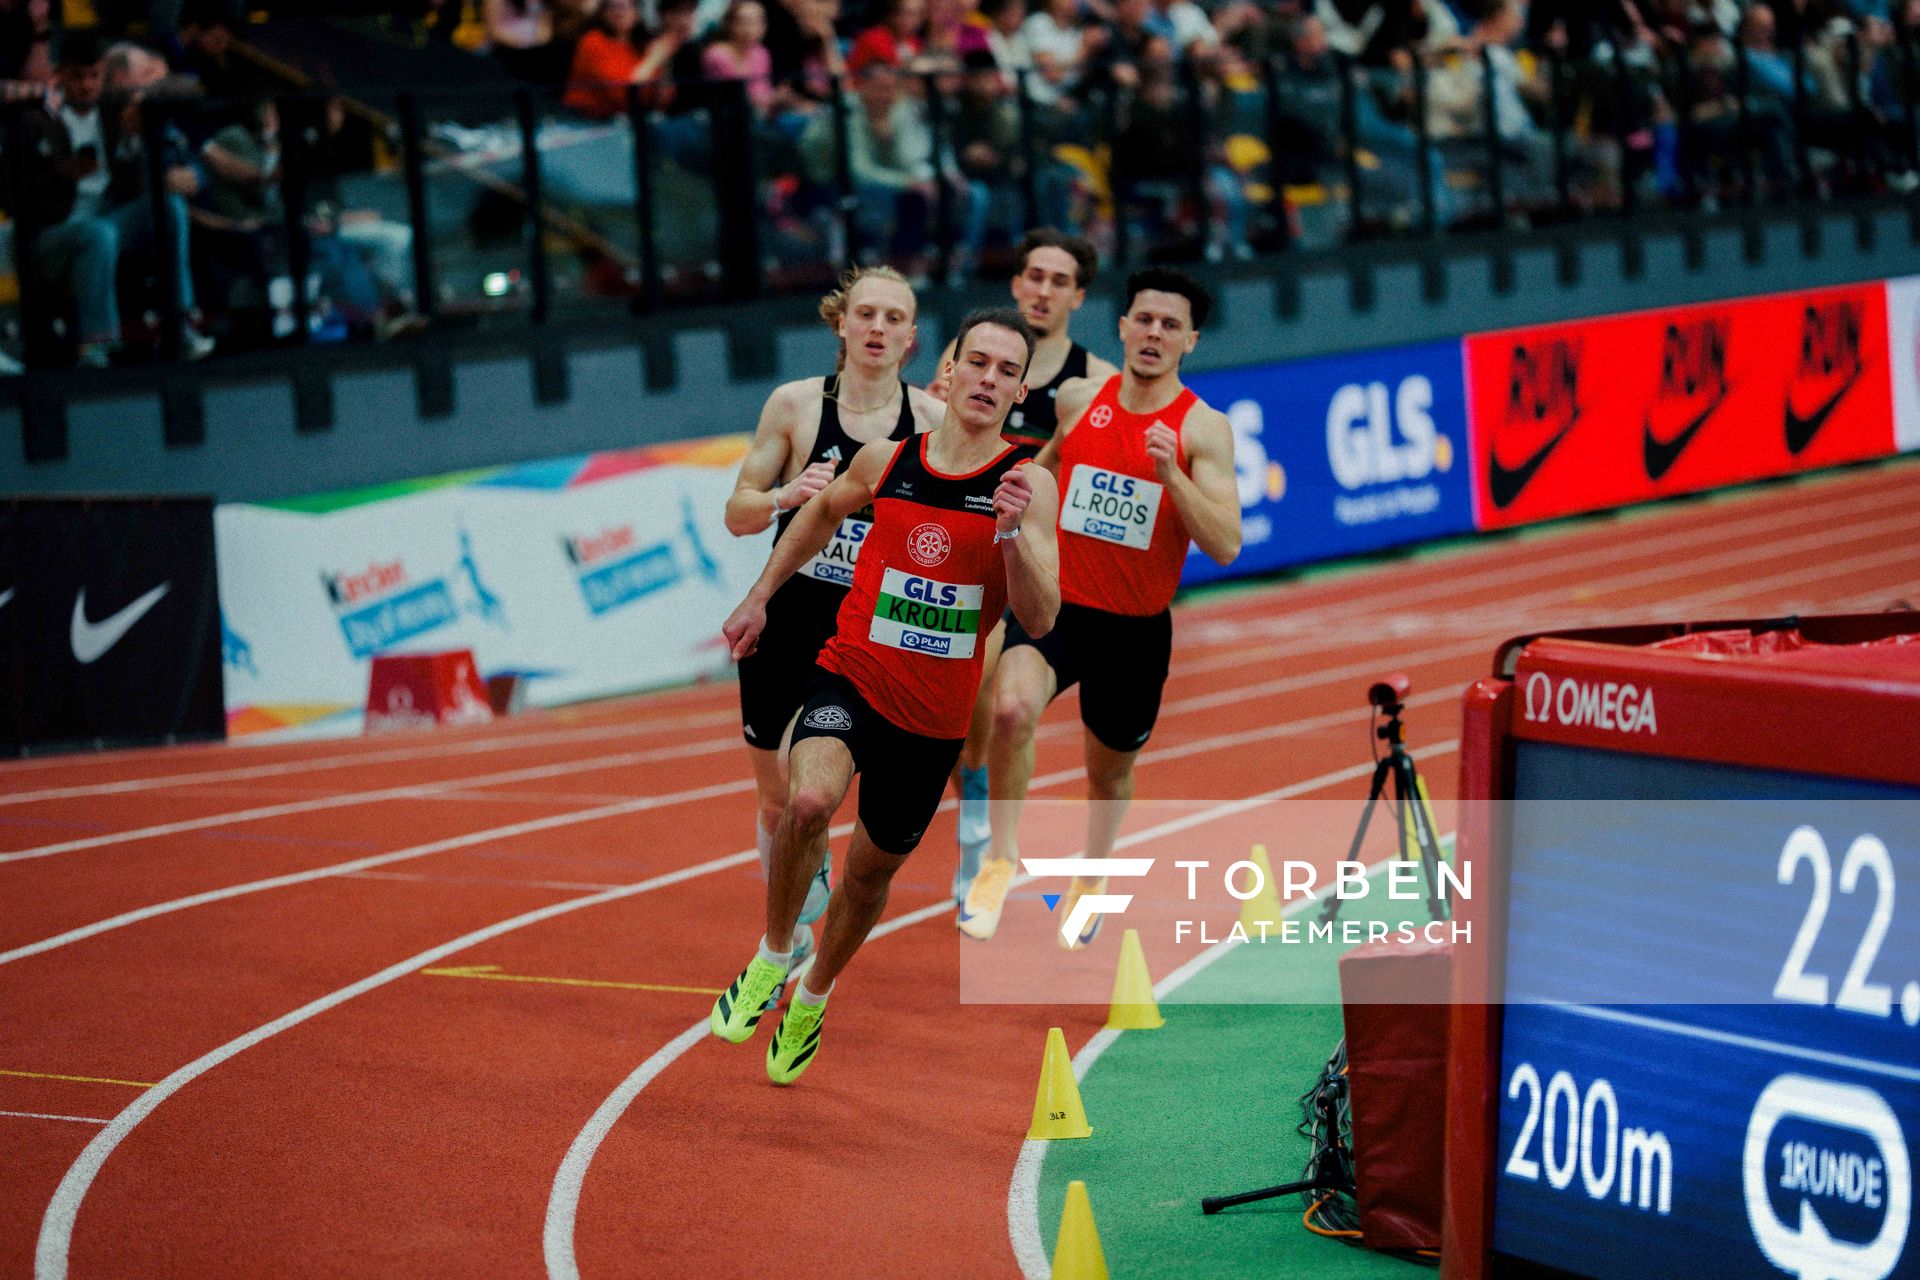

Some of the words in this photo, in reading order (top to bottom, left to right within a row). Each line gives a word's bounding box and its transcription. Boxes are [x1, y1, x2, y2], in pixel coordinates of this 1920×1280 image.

[1072, 488, 1148, 525] L.ROOS
[835, 522, 866, 542] LS
[888, 597, 966, 633] KROLL
[921, 637, 949, 649] PLAN
[1556, 678, 1657, 736] OMEGA
[1505, 1062, 1673, 1216] 200m
